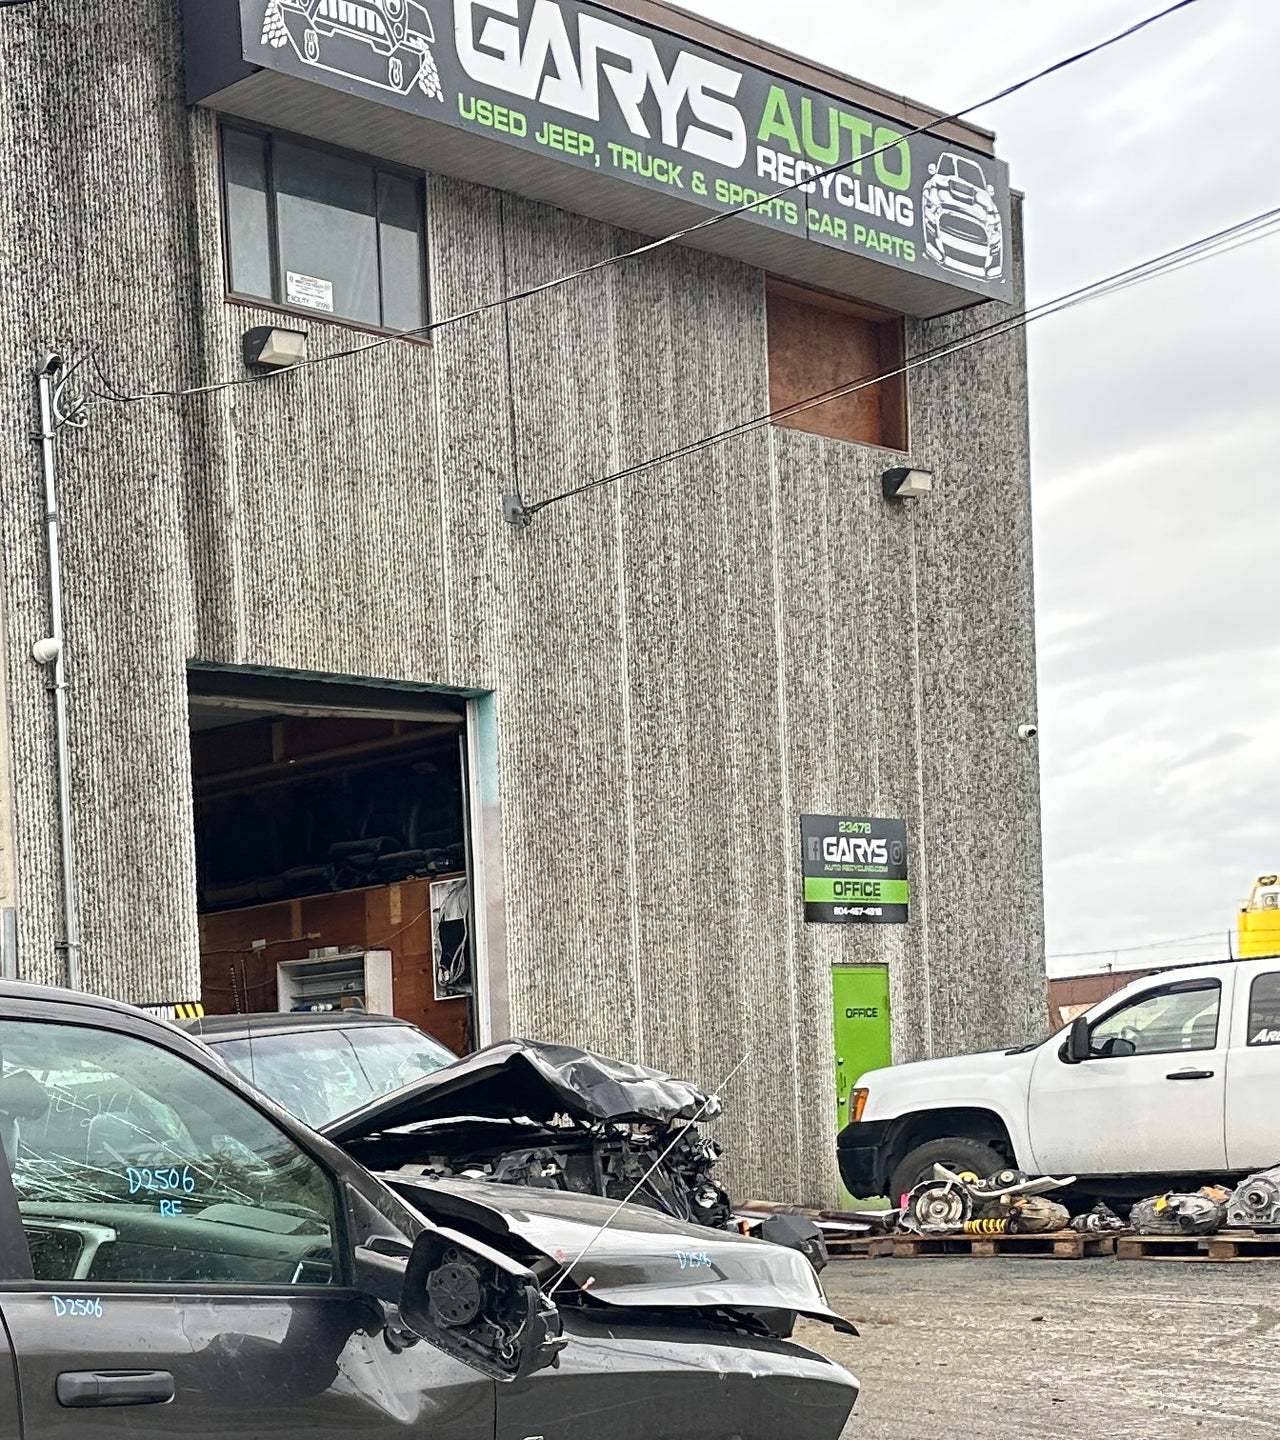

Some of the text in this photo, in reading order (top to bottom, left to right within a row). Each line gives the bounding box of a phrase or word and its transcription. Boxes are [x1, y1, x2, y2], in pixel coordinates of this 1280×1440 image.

[453, 0, 747, 169] GARYS
[757, 85, 912, 191] AUTO
[457, 92, 916, 263] USED JEEP, TRUCK & SPORTS CAR PARTS
[756, 145, 915, 228] RECYCLING
[838, 821, 872, 834] 23478
[822, 836, 889, 864] GARYS
[833, 880, 881, 897] OFFICE
[845, 1007, 878, 1018] OFFICE
[126, 1165, 195, 1194] D2506
[160, 1199, 182, 1217] RF
[51, 1295, 103, 1318] D2506
